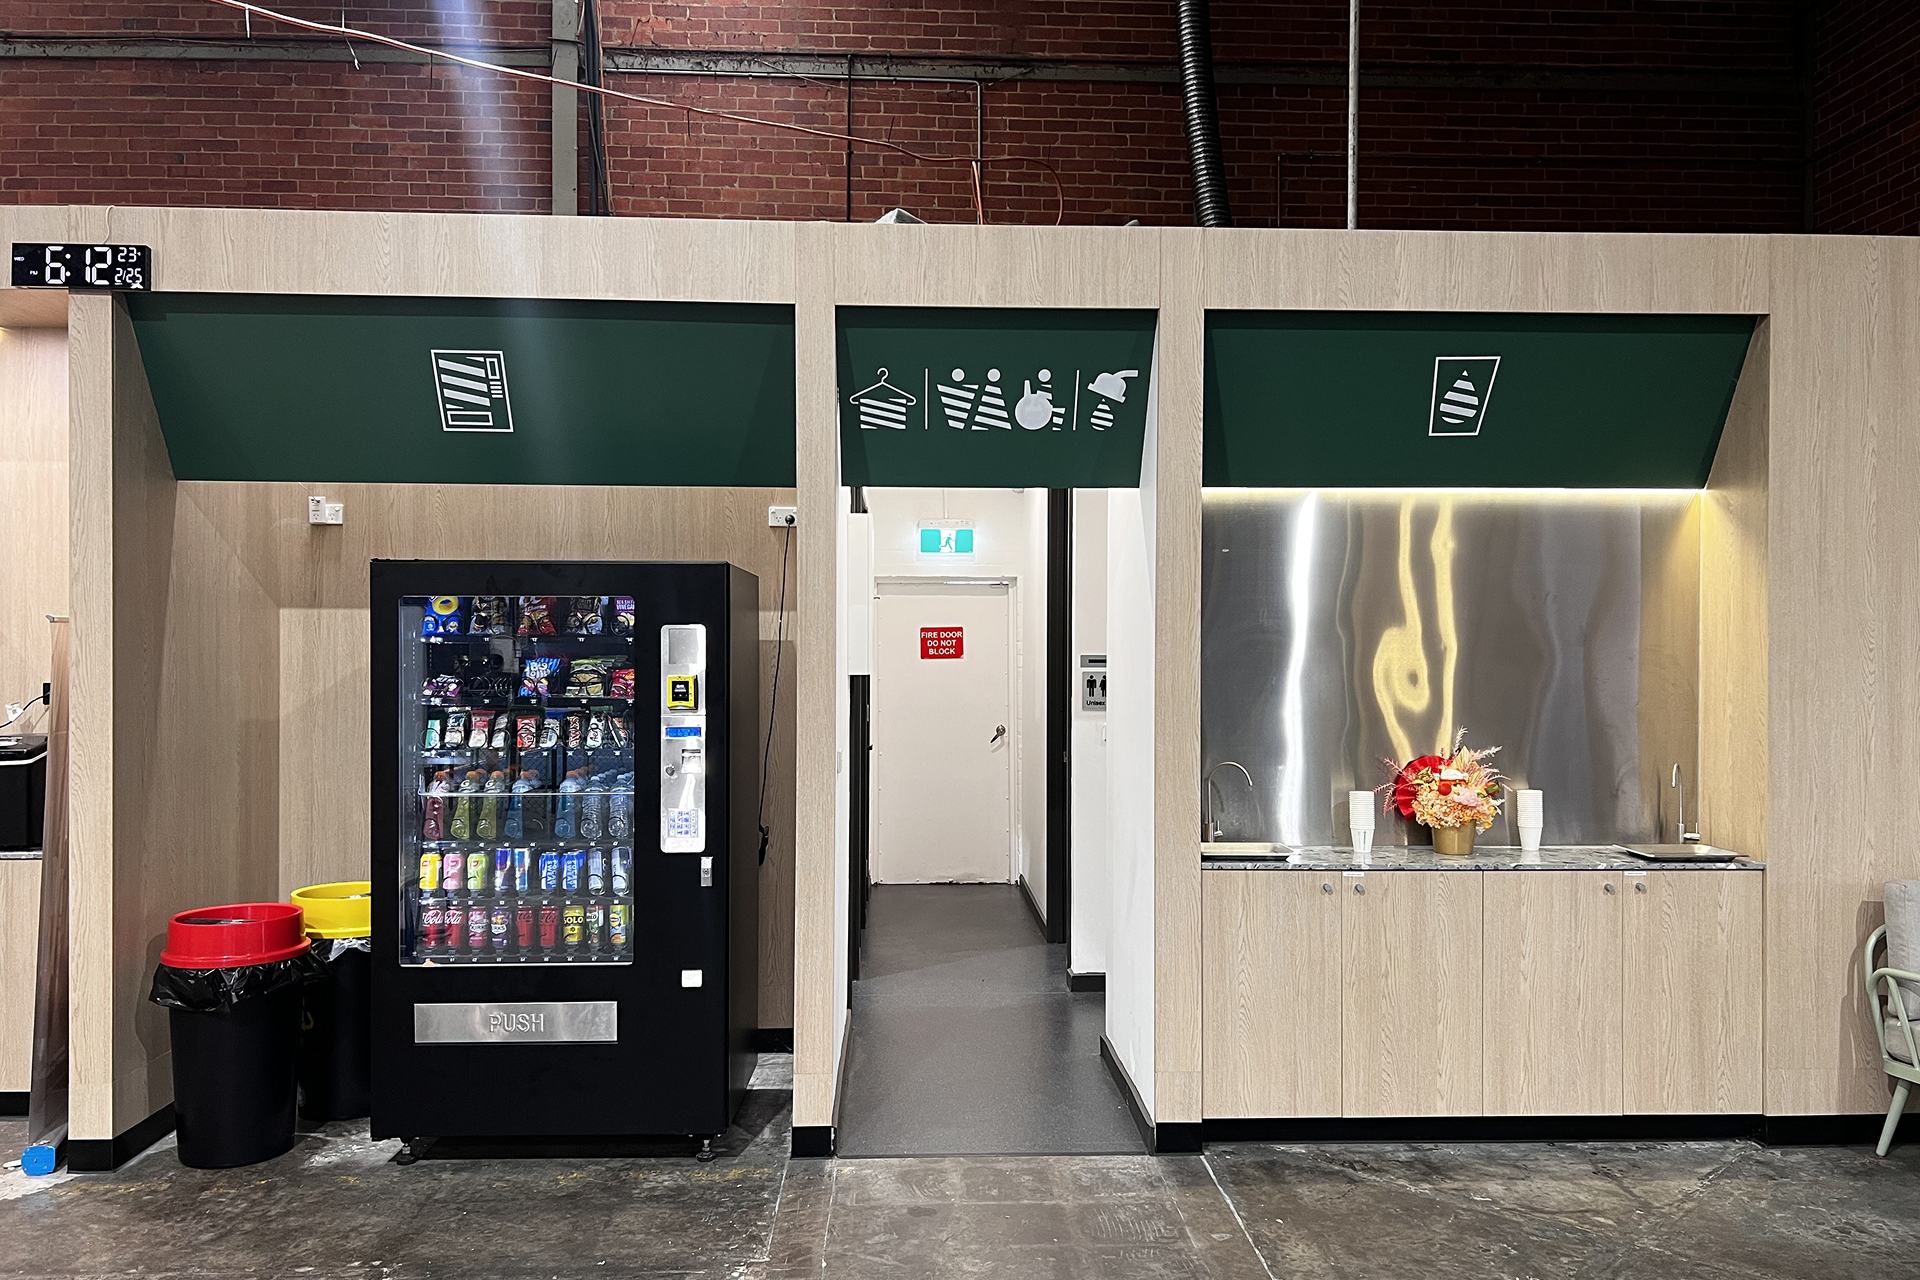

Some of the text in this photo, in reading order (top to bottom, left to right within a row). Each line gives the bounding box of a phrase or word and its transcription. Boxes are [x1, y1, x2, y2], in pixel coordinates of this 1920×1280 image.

[45, 246, 112, 285] 6:12
[114, 268, 143, 283] 2/25
[563, 916, 583, 924] SOLO
[489, 1013, 544, 1033] PUSH
